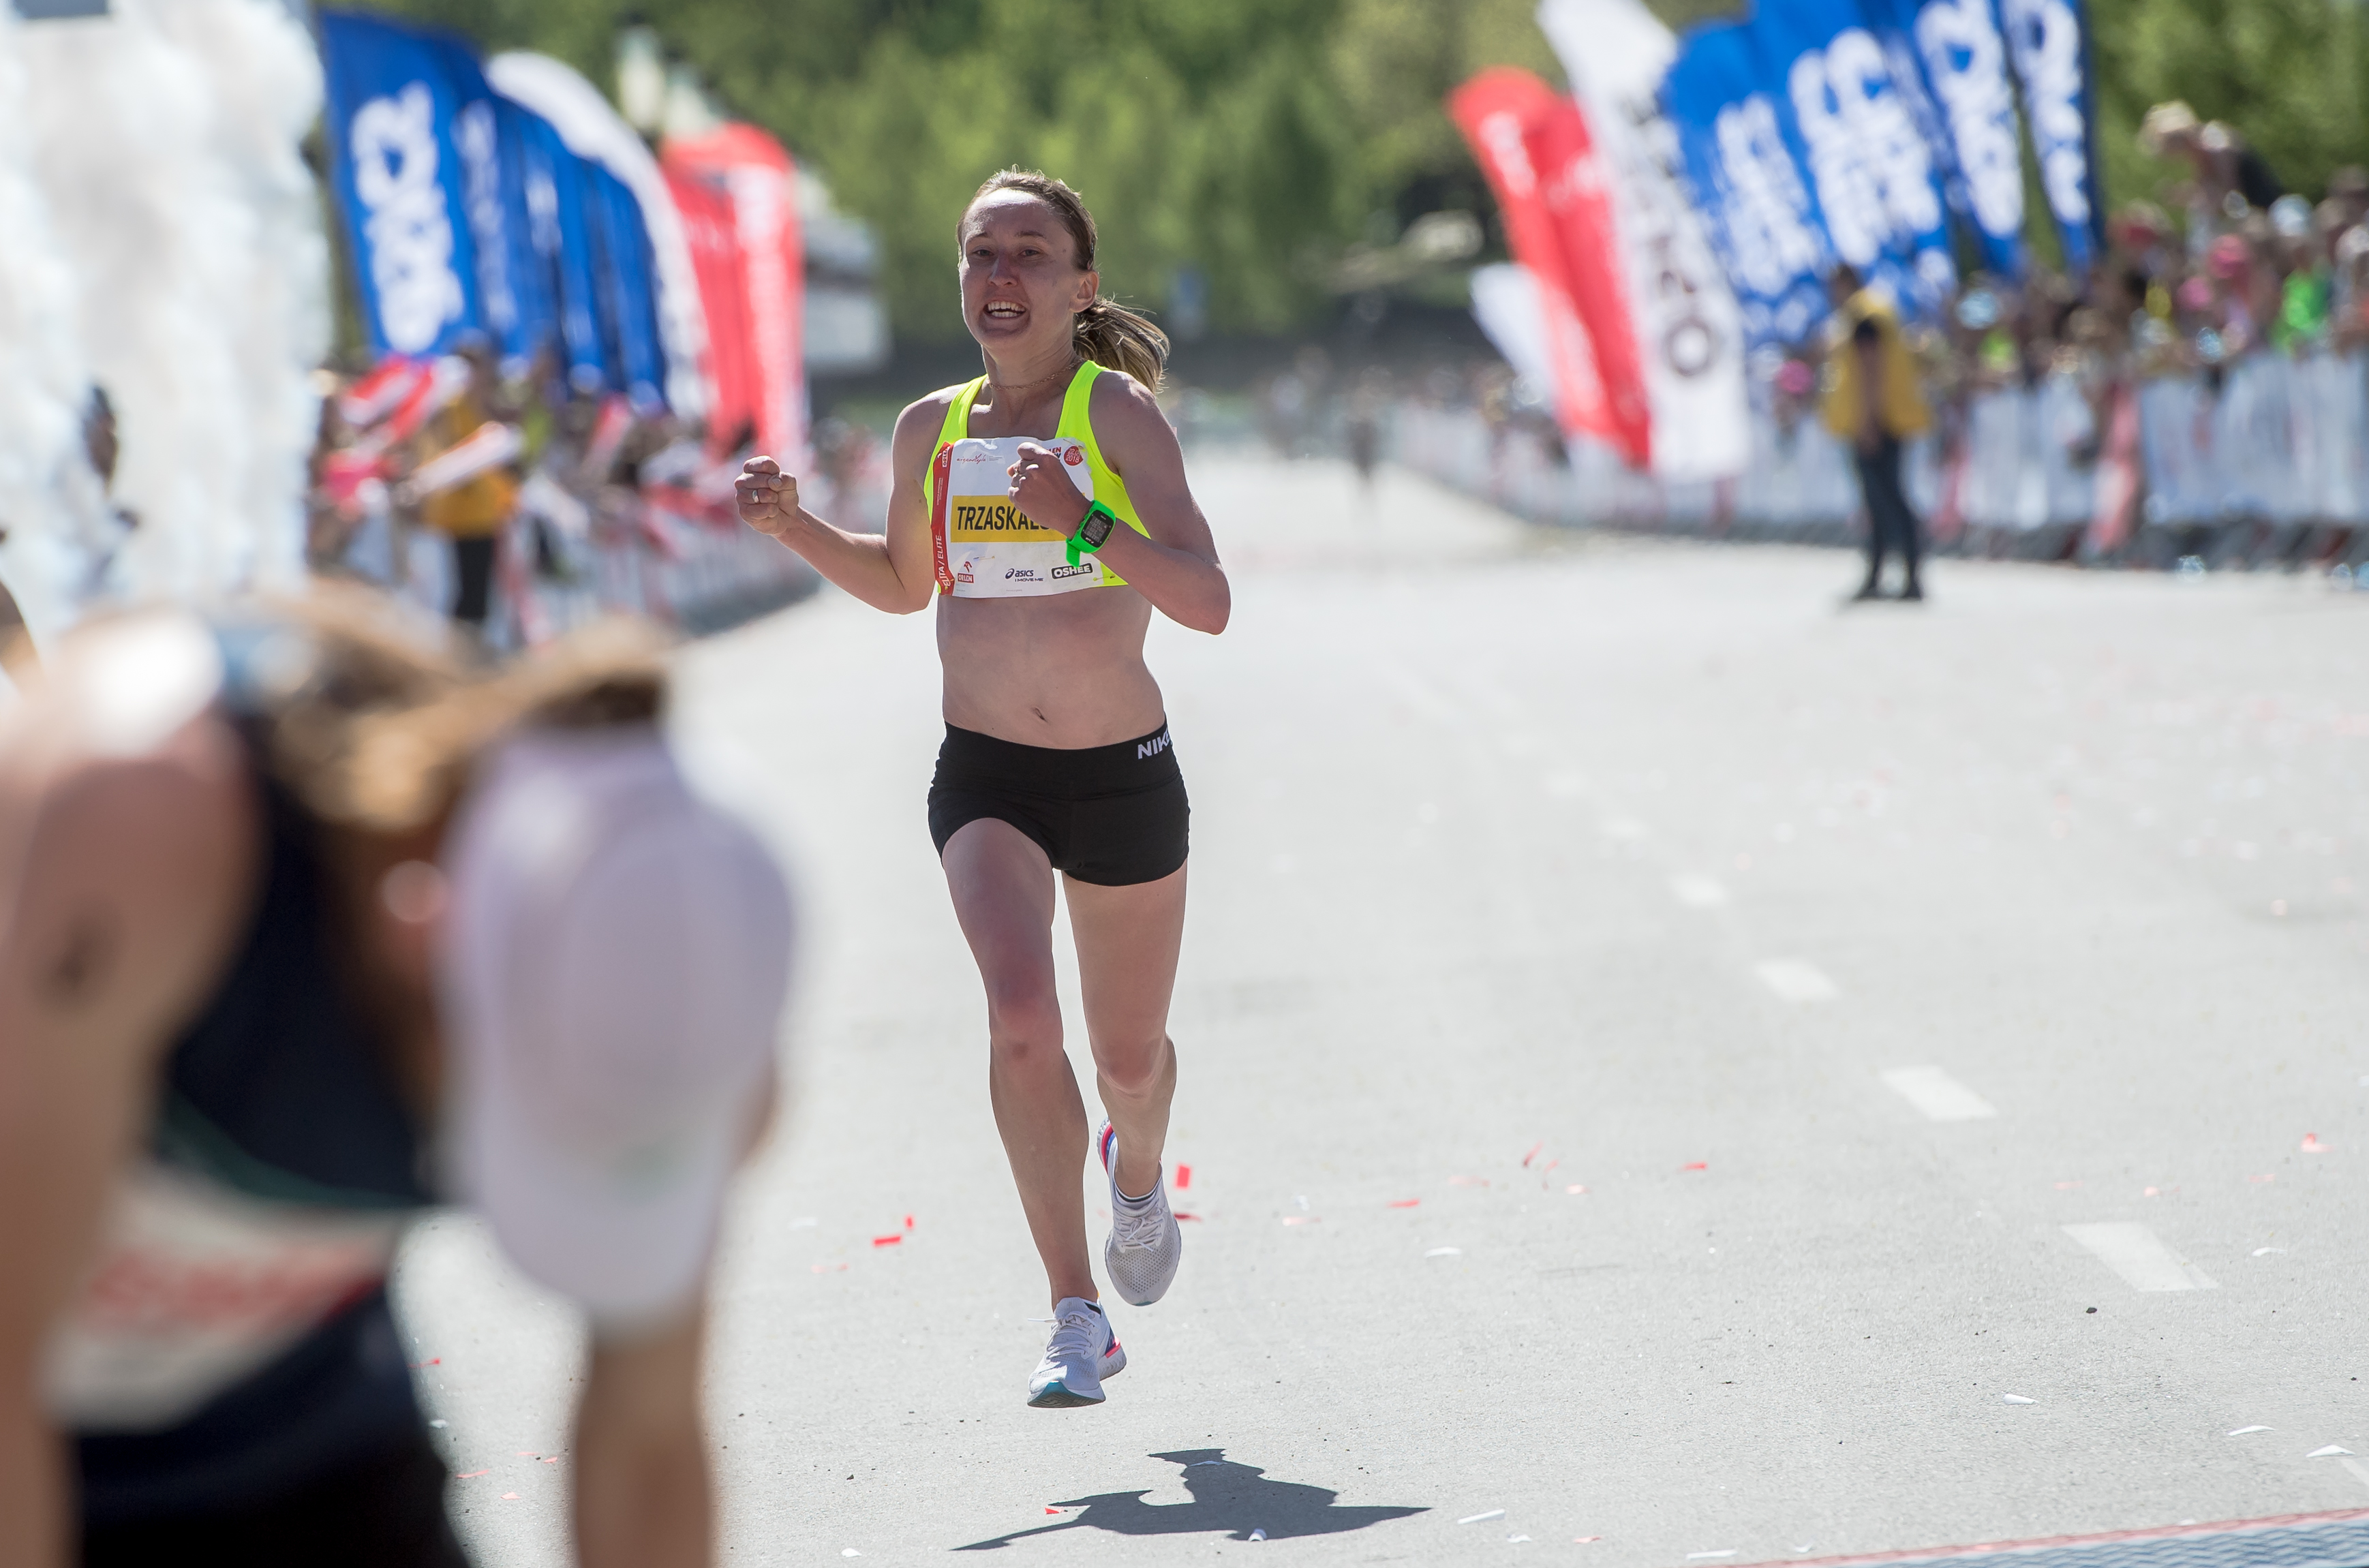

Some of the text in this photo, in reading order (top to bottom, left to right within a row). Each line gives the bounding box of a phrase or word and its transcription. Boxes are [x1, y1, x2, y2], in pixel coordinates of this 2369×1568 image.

[1065, 455, 1080, 463] 2018
[958, 506, 1050, 530] TRZASKAL
[936, 535, 944, 559] ELITE
[1054, 565, 1090, 577] OSHEE
[958, 574, 973, 583] ORLEN
